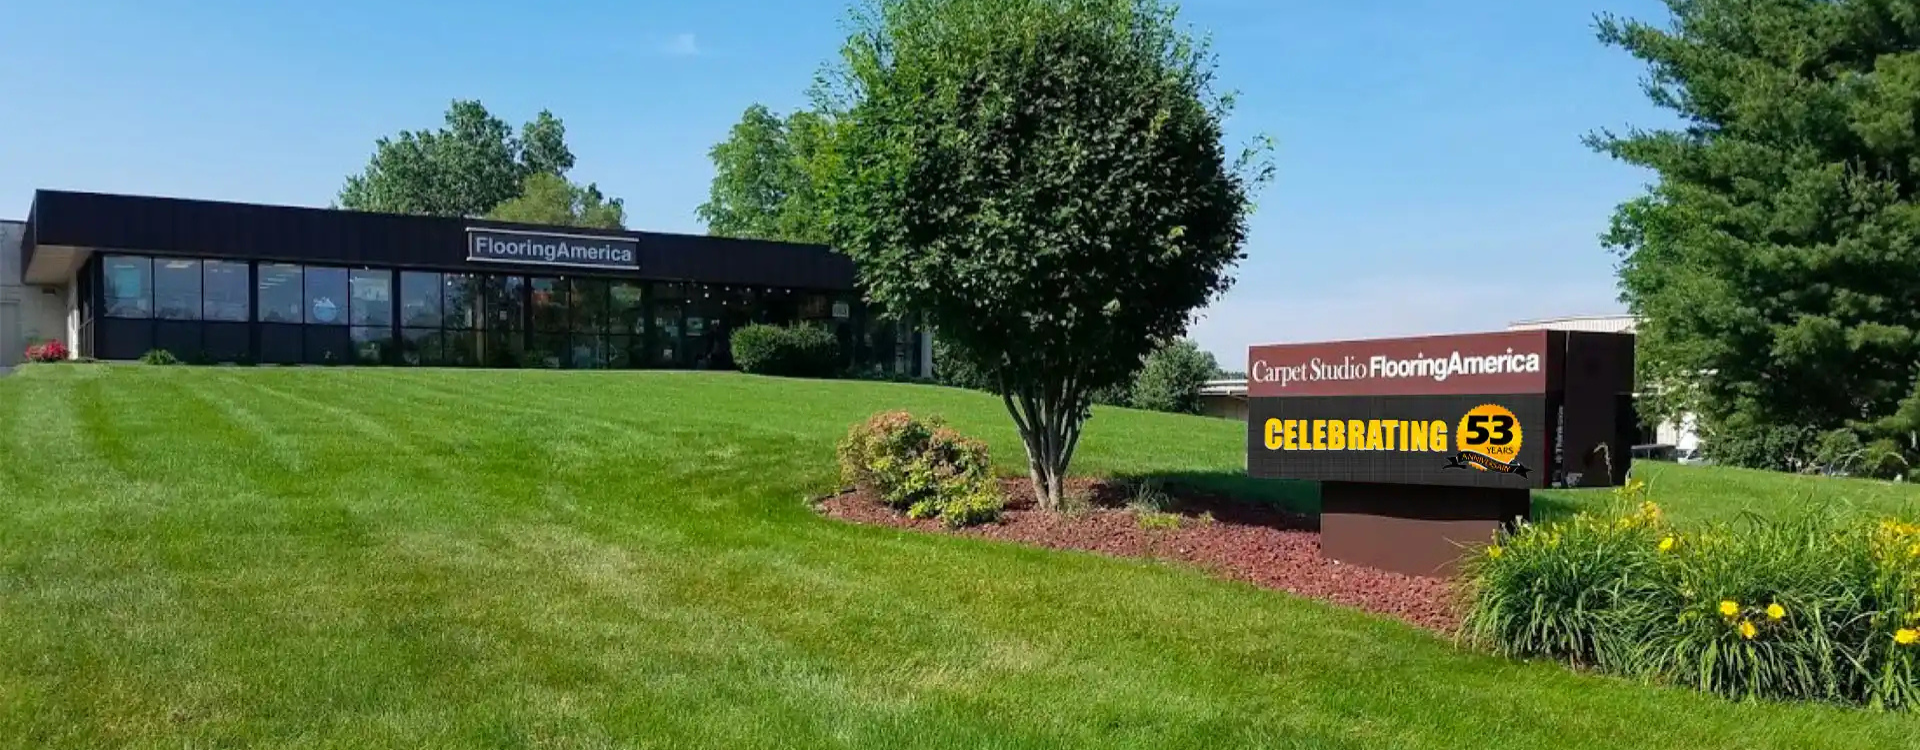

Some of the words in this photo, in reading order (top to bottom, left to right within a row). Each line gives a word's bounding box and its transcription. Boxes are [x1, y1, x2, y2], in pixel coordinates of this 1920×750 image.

[476, 237, 632, 262] FlooringAmerica
[1252, 359, 1307, 386] Carpet
[1309, 356, 1366, 381] Studio
[1369, 347, 1540, 381] FlooringAmerica
[1264, 417, 1448, 452] CELEBRATING
[1466, 415, 1514, 445] 53
[1461, 453, 1511, 473] ANNIVERSARY
[1486, 446, 1514, 455] YEARS
